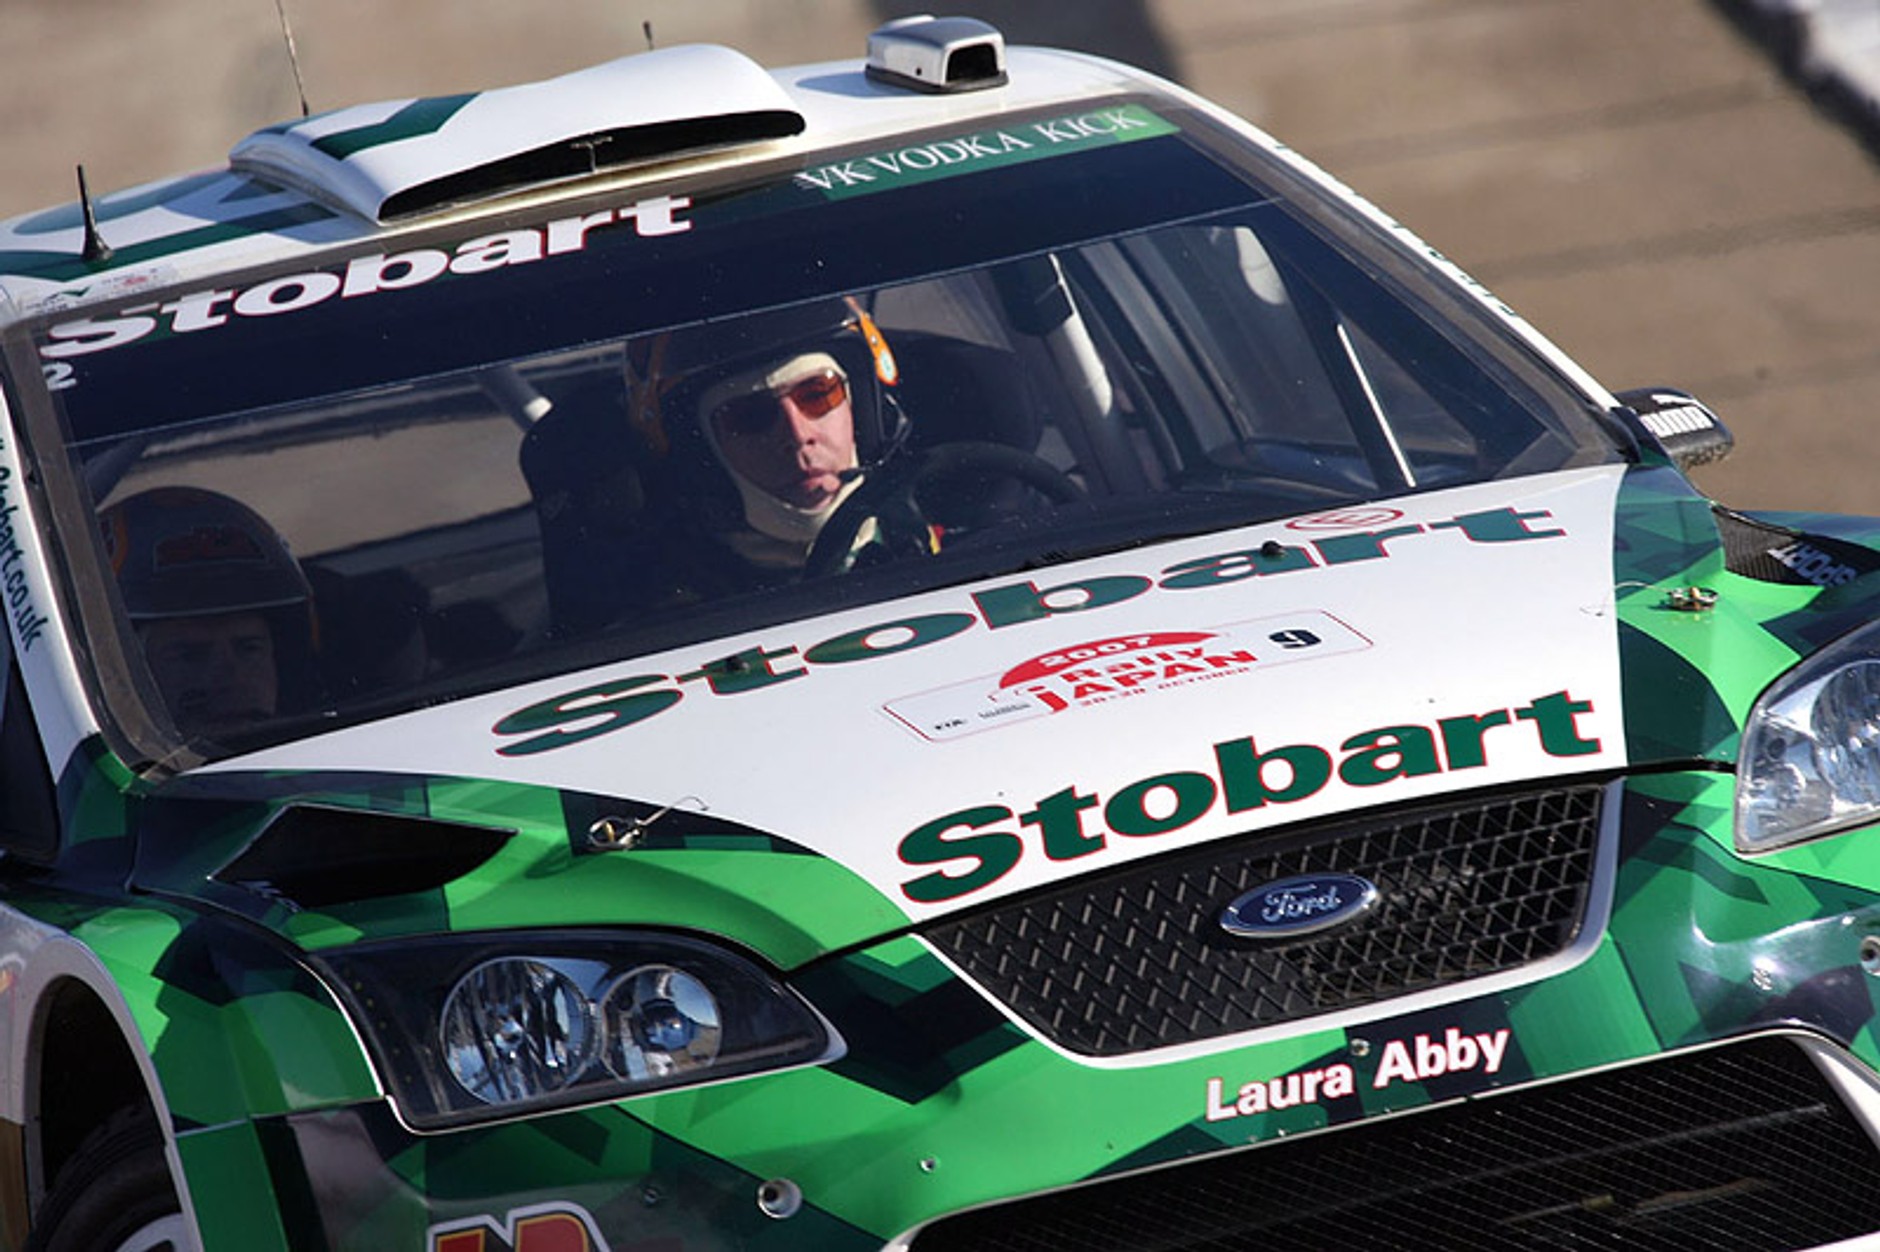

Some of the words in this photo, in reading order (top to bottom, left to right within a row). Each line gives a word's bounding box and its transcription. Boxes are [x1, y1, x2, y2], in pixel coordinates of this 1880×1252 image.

[796, 161, 877, 190] VK
[866, 133, 1034, 175] VODKA
[1035, 109, 1148, 143] KICK
[39, 196, 692, 358] Stobart
[1640, 407, 1714, 438] UMA
[1766, 541, 1857, 588] SPORT
[492, 506, 1567, 757] Stobart
[1037, 635, 1153, 669] 2007
[1268, 628, 1322, 649] 9
[1060, 647, 1203, 683] Rally
[897, 689, 1602, 904] Stobart
[1261, 884, 1342, 923] Ford
[1206, 1063, 1354, 1122] Laura
[1373, 1028, 1511, 1089] Abby
